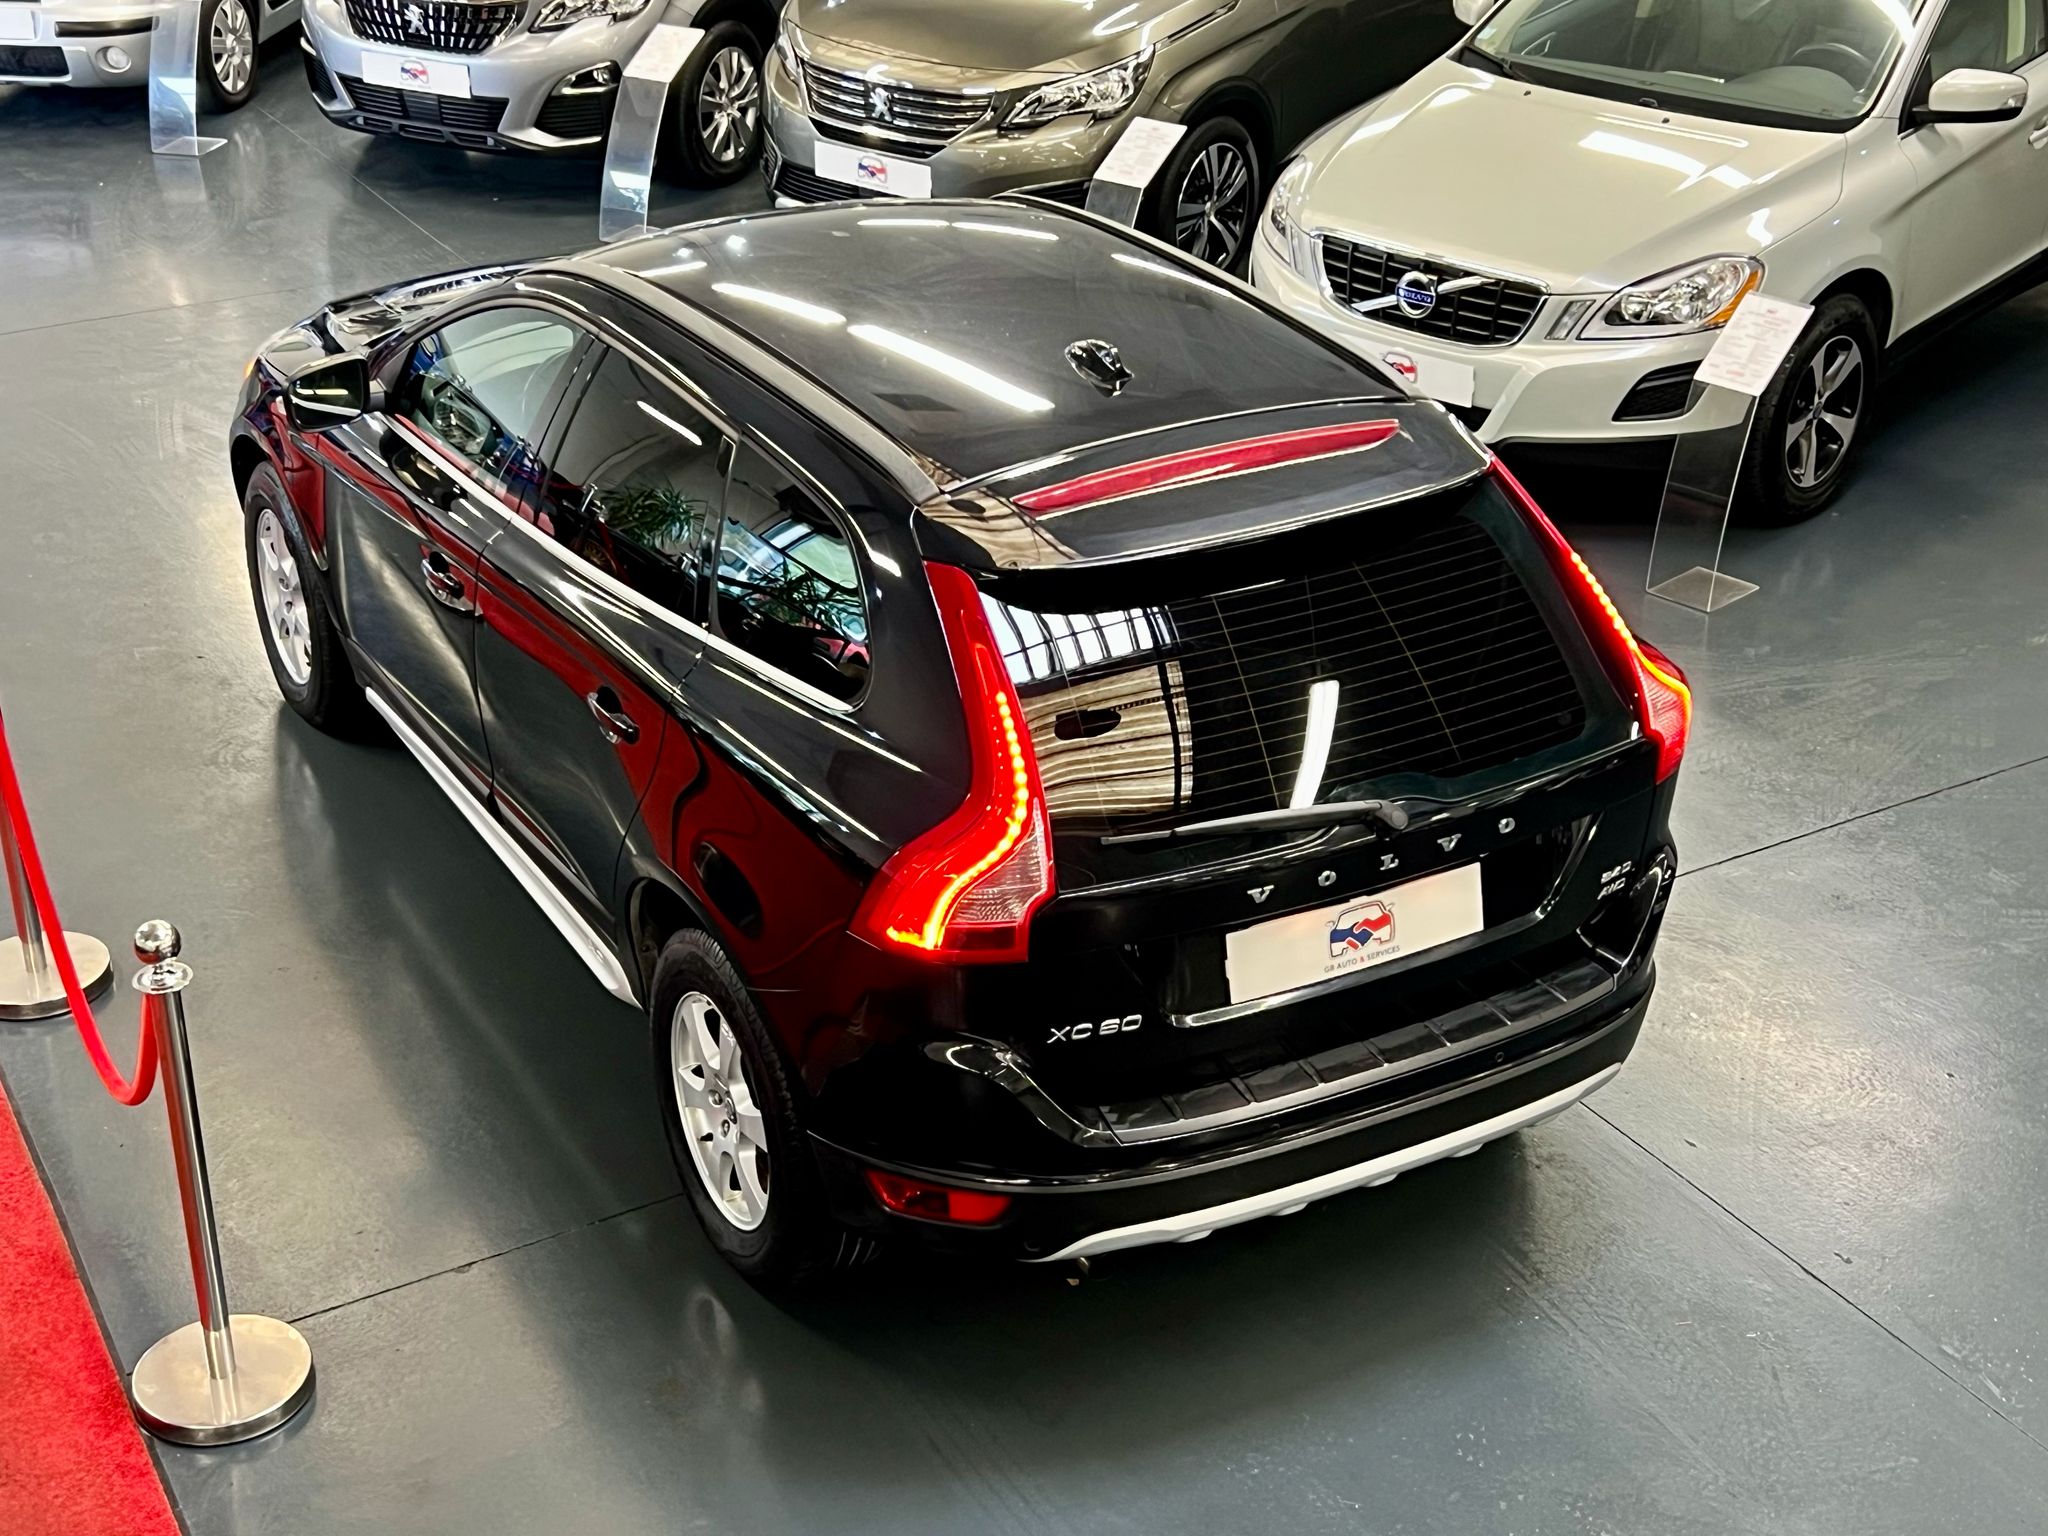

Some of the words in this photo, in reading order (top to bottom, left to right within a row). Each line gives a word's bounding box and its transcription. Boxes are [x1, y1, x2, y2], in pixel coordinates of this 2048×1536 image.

[1247, 817, 1516, 903] VOLVO
[1337, 958, 1357, 969] AUTO
[1366, 945, 1400, 960] SERVICES
